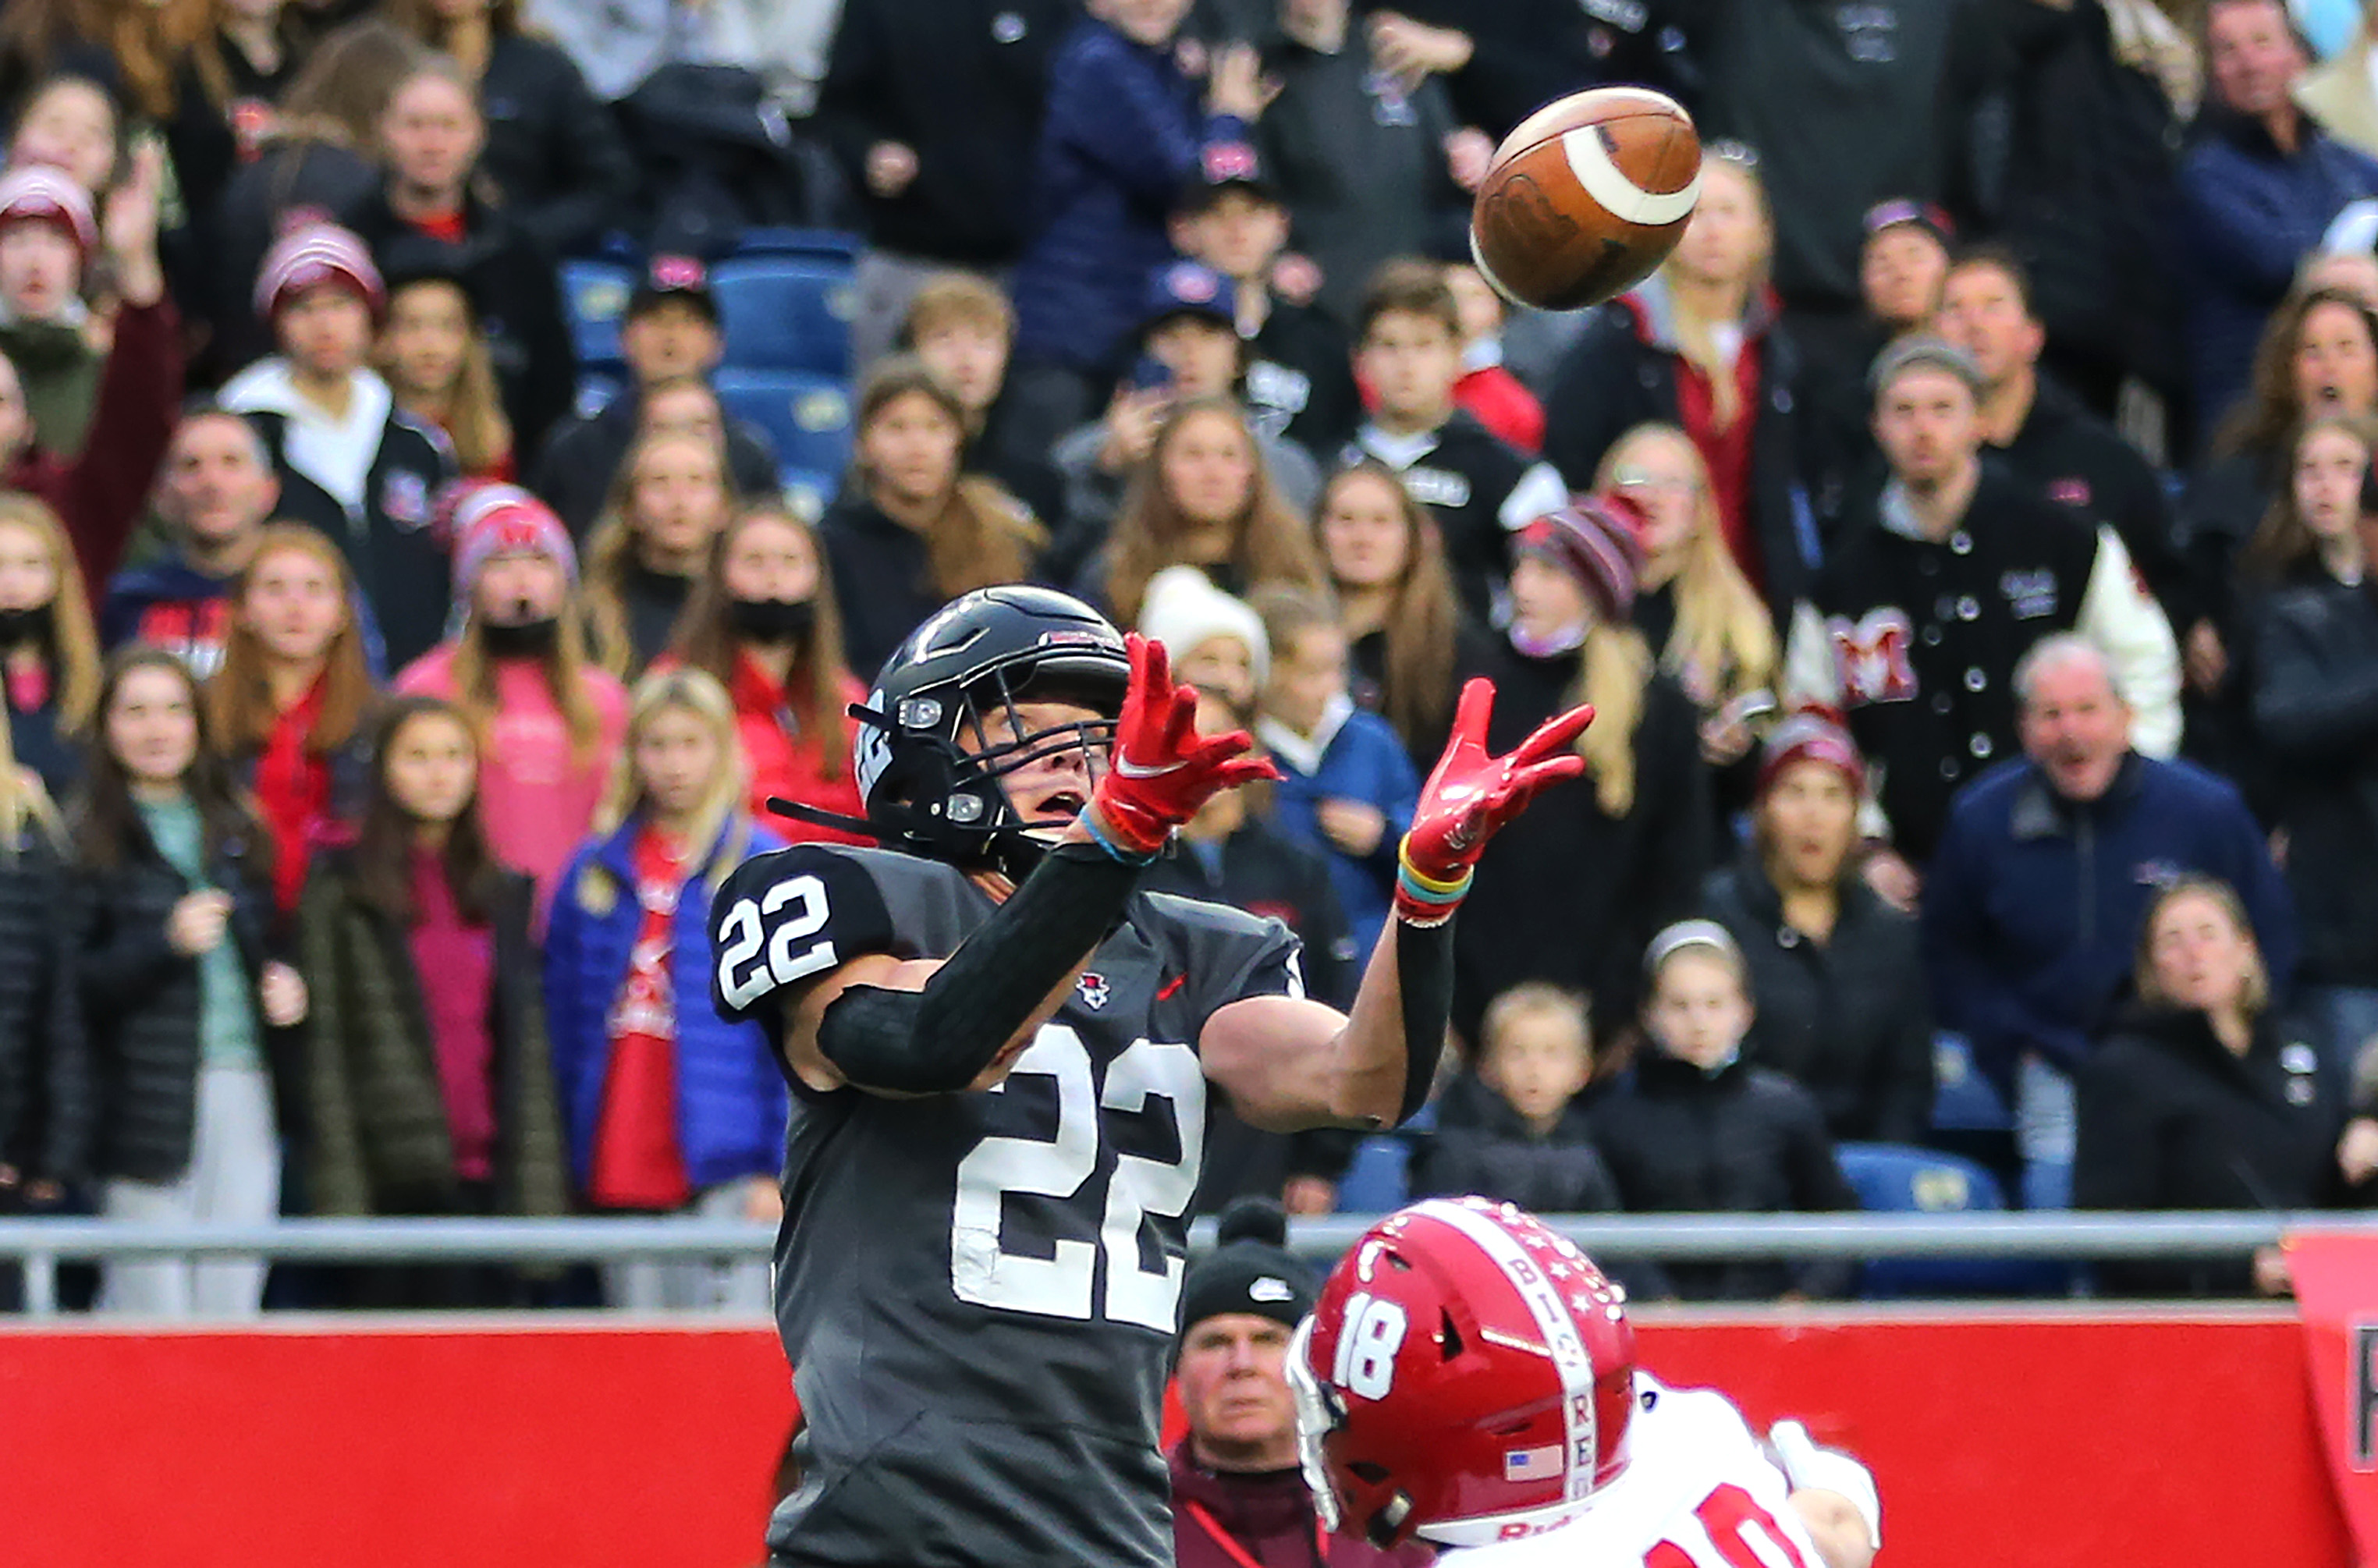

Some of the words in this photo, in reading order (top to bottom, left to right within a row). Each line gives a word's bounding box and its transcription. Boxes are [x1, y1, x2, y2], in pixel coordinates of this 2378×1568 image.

[1827, 607, 1918, 711] M
[719, 874, 839, 1011] 22
[951, 1023, 1206, 1335] 22
[1333, 1291, 1407, 1401] 18
